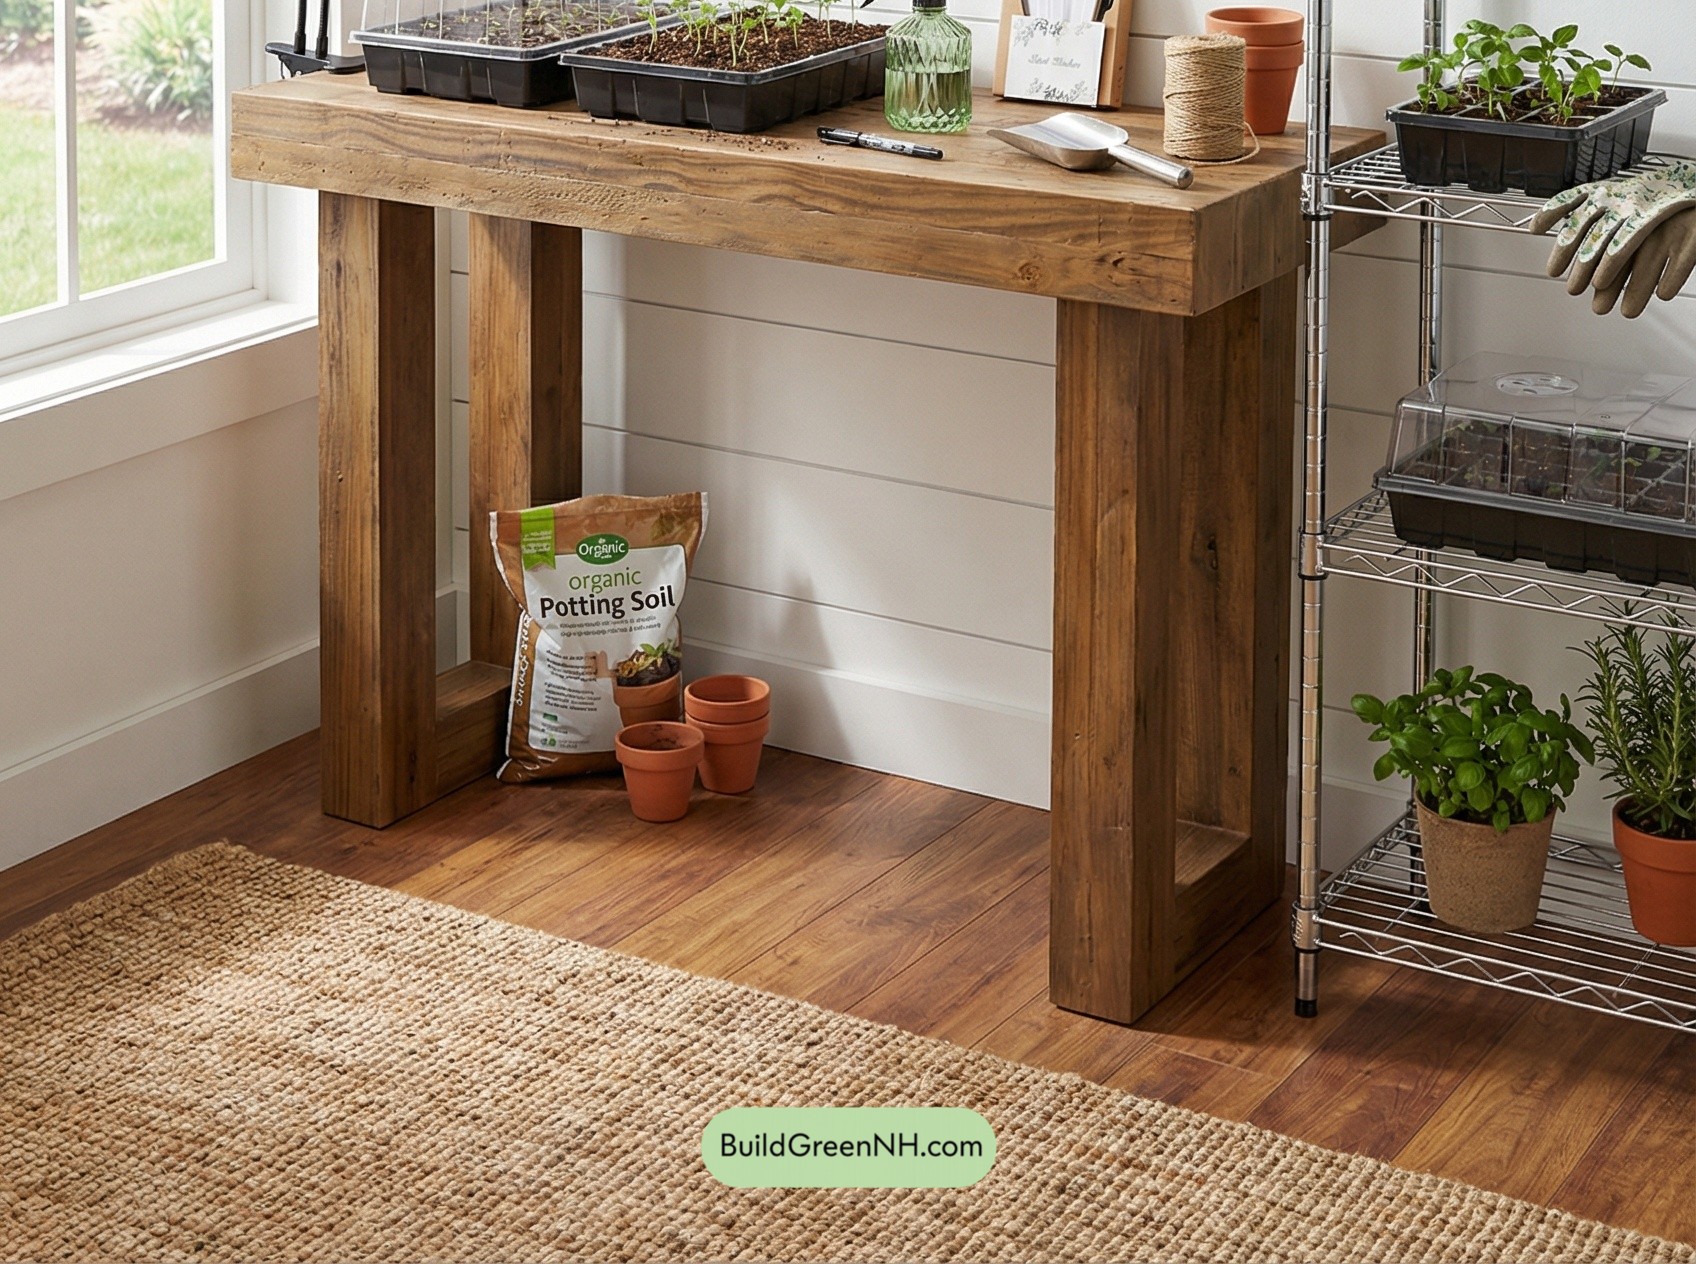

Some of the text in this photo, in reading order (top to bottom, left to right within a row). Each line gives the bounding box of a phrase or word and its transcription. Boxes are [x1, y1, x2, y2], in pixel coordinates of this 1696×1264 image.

[578, 539, 626, 558] Organic
[569, 567, 641, 594] organic
[540, 585, 675, 619] Potting Soil
